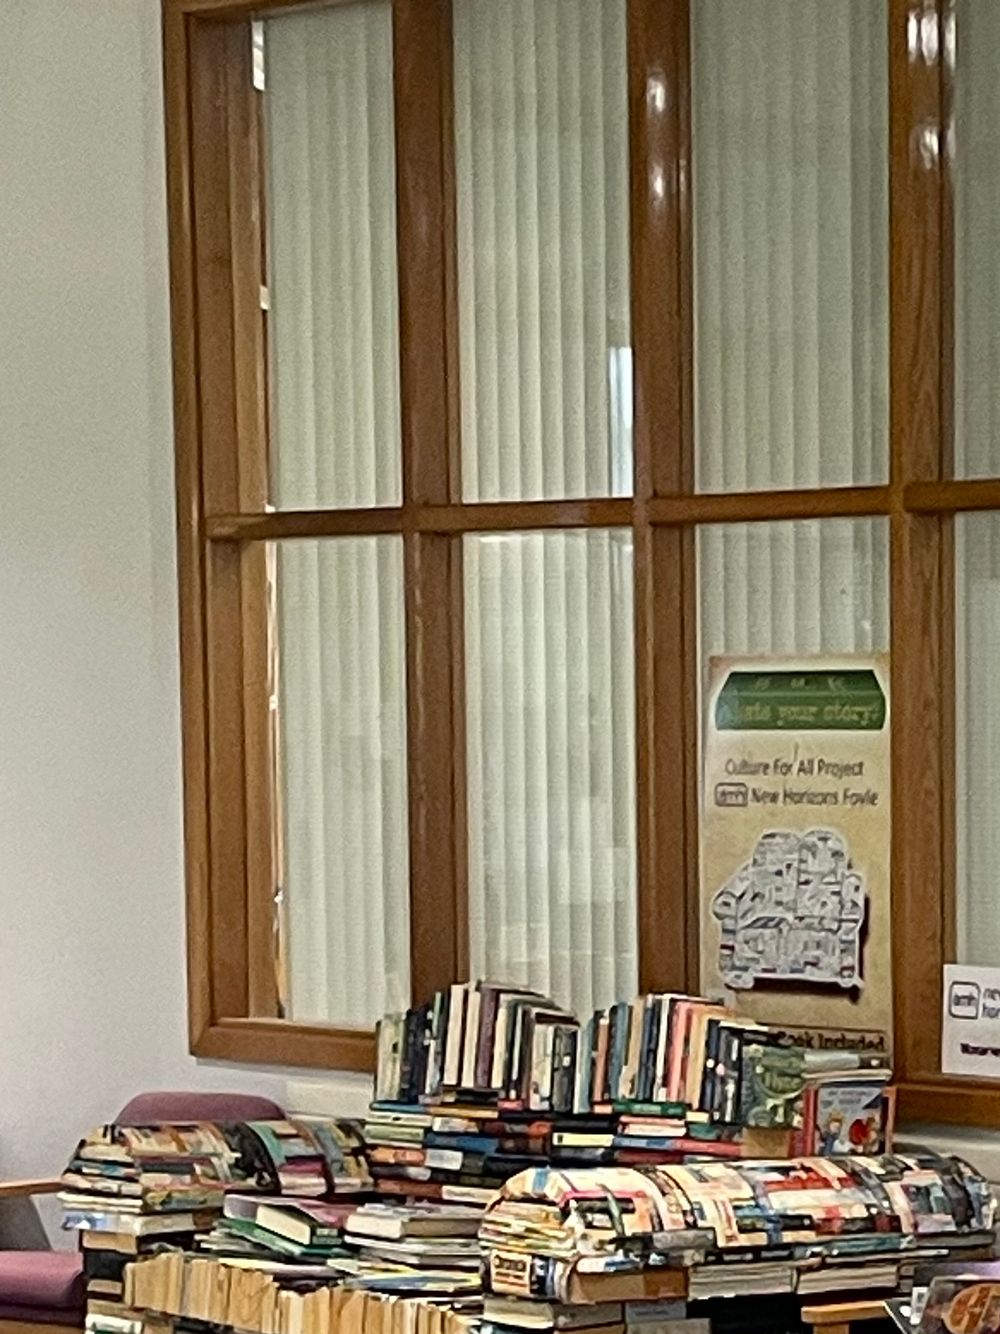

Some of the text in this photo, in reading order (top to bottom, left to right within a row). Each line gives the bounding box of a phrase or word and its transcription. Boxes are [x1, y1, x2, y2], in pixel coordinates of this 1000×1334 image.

[725, 758, 864, 779] Culture For All Project
[751, 787, 879, 806] New Horizons Foyle
[818, 1033, 885, 1051] Included
